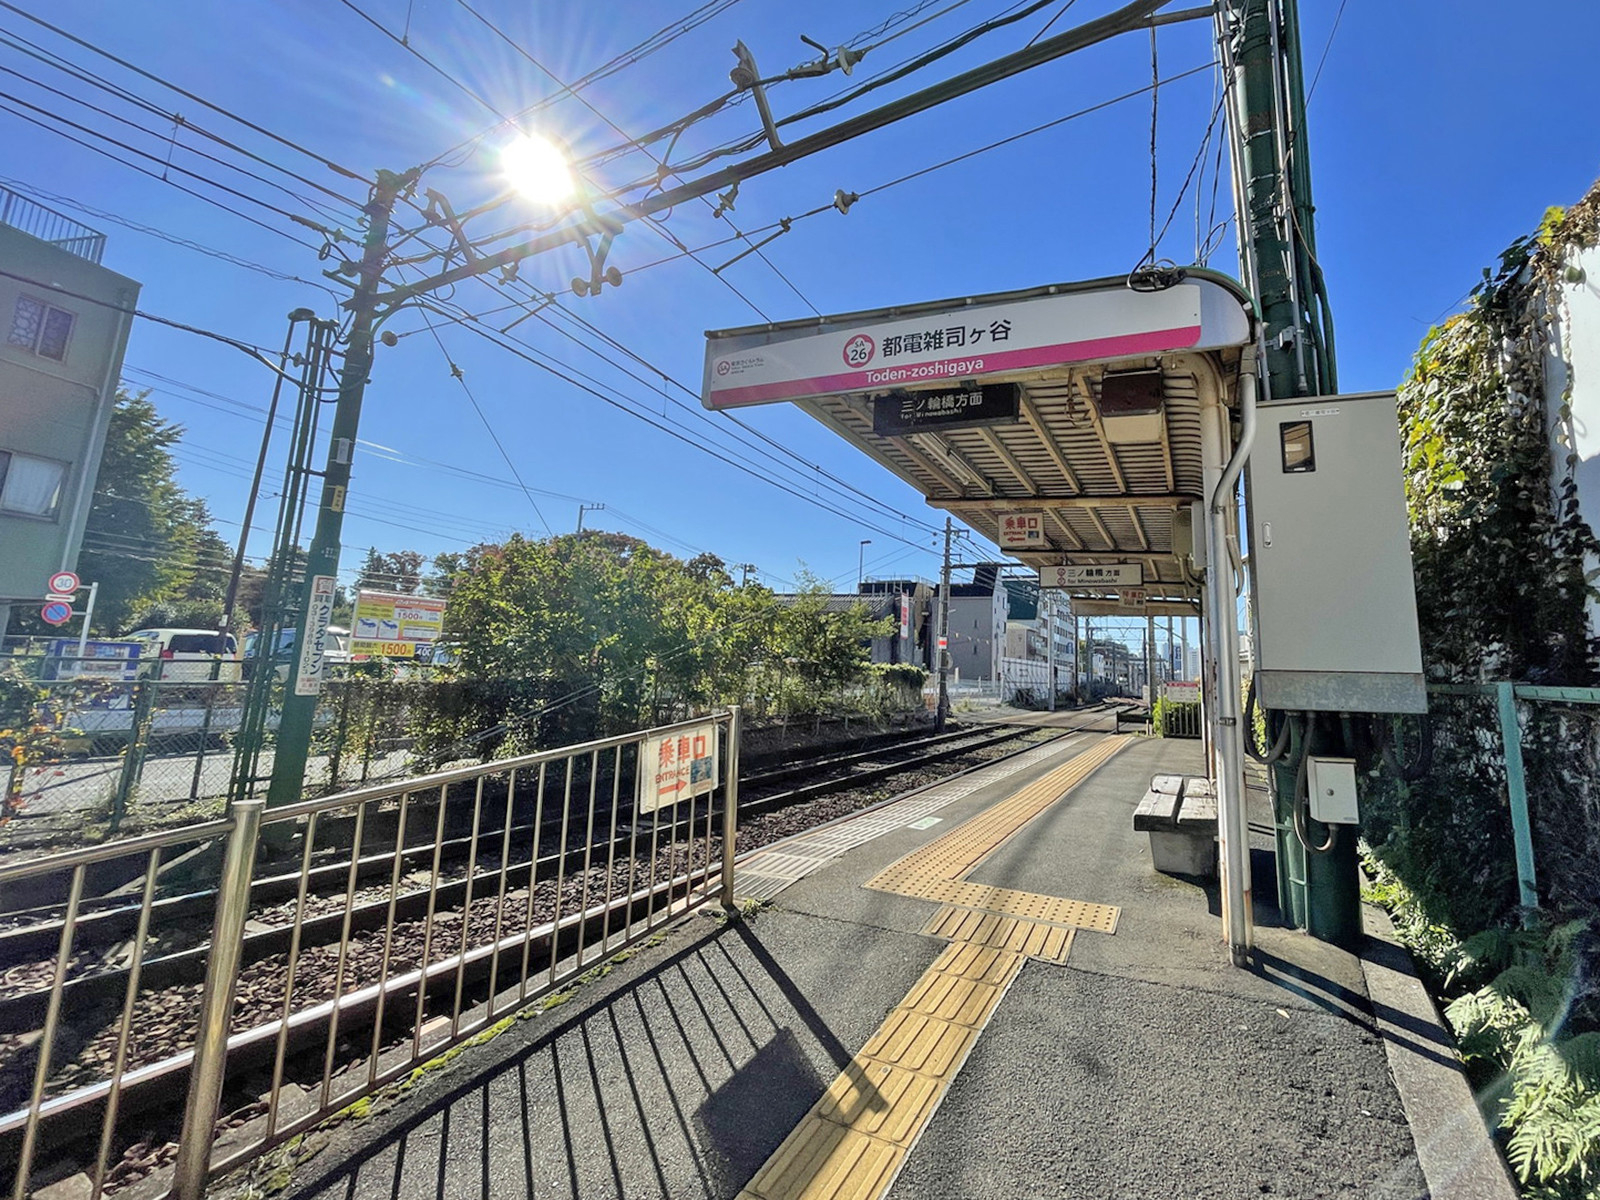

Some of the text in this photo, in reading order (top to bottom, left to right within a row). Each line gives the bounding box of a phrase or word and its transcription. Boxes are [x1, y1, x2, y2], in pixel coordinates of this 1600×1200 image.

[854, 340, 865, 349] SA
[882, 319, 1012, 358] 都電雑司ヶ谷
[850, 349, 867, 361] 26
[866, 359, 984, 383] Toden-zoshigaya
[1005, 516, 1038, 530] 乗車口
[56, 579, 73, 588] 30
[659, 735, 706, 768] 乗車口
